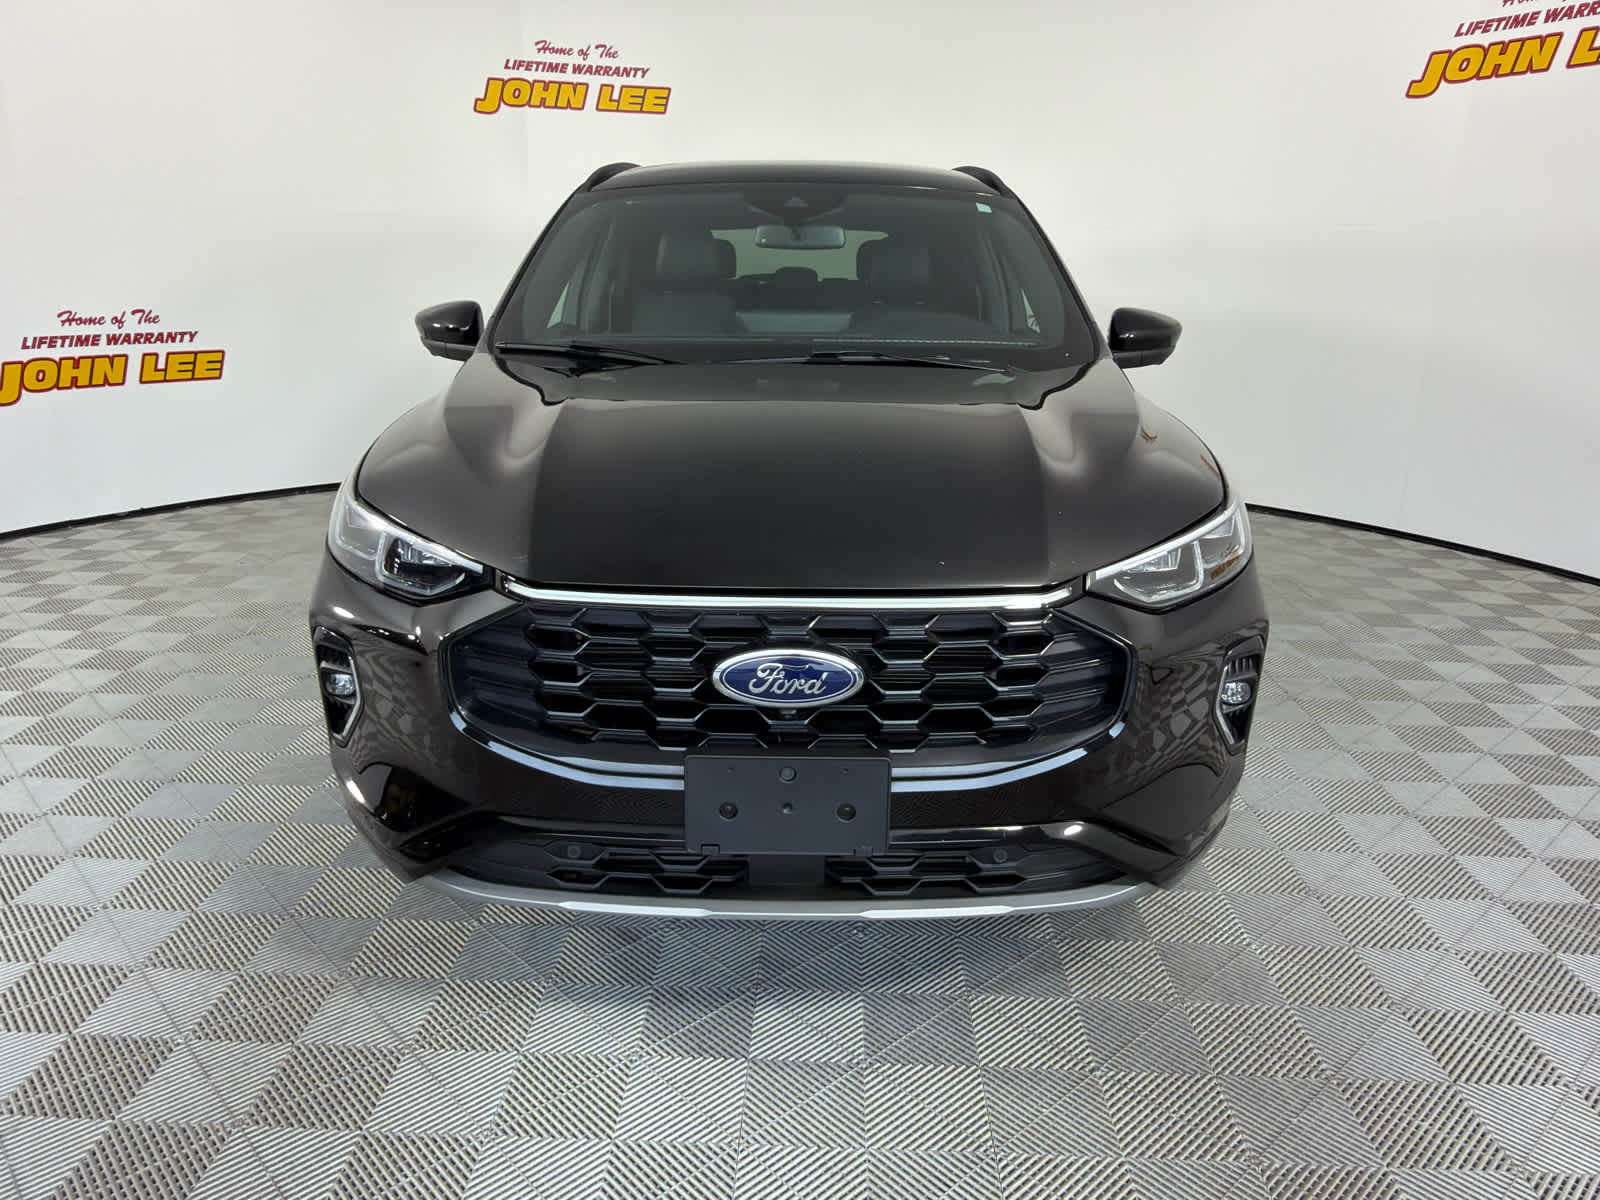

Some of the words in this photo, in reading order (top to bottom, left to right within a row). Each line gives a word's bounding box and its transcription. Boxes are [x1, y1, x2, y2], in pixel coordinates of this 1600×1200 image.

[1454, 10, 1542, 37] LIFETIME
[534, 39, 573, 56] Home
[578, 45, 591, 61] of
[595, 44, 619, 59] The
[504, 58, 569, 74] LIFETIME
[571, 63, 650, 79] WARRANTY
[1405, 32, 1564, 99] JOHN
[473, 77, 589, 115] JOHN
[596, 83, 671, 115] LEE
[57, 310, 106, 327] Home
[111, 310, 126, 329] of
[131, 309, 160, 325] The
[21, 334, 101, 350] LIFETIME
[106, 331, 199, 347] WARRANTY
[0, 354, 128, 407] JOHN
[139, 350, 225, 384] LEE
[748, 662, 828, 695] Ford
